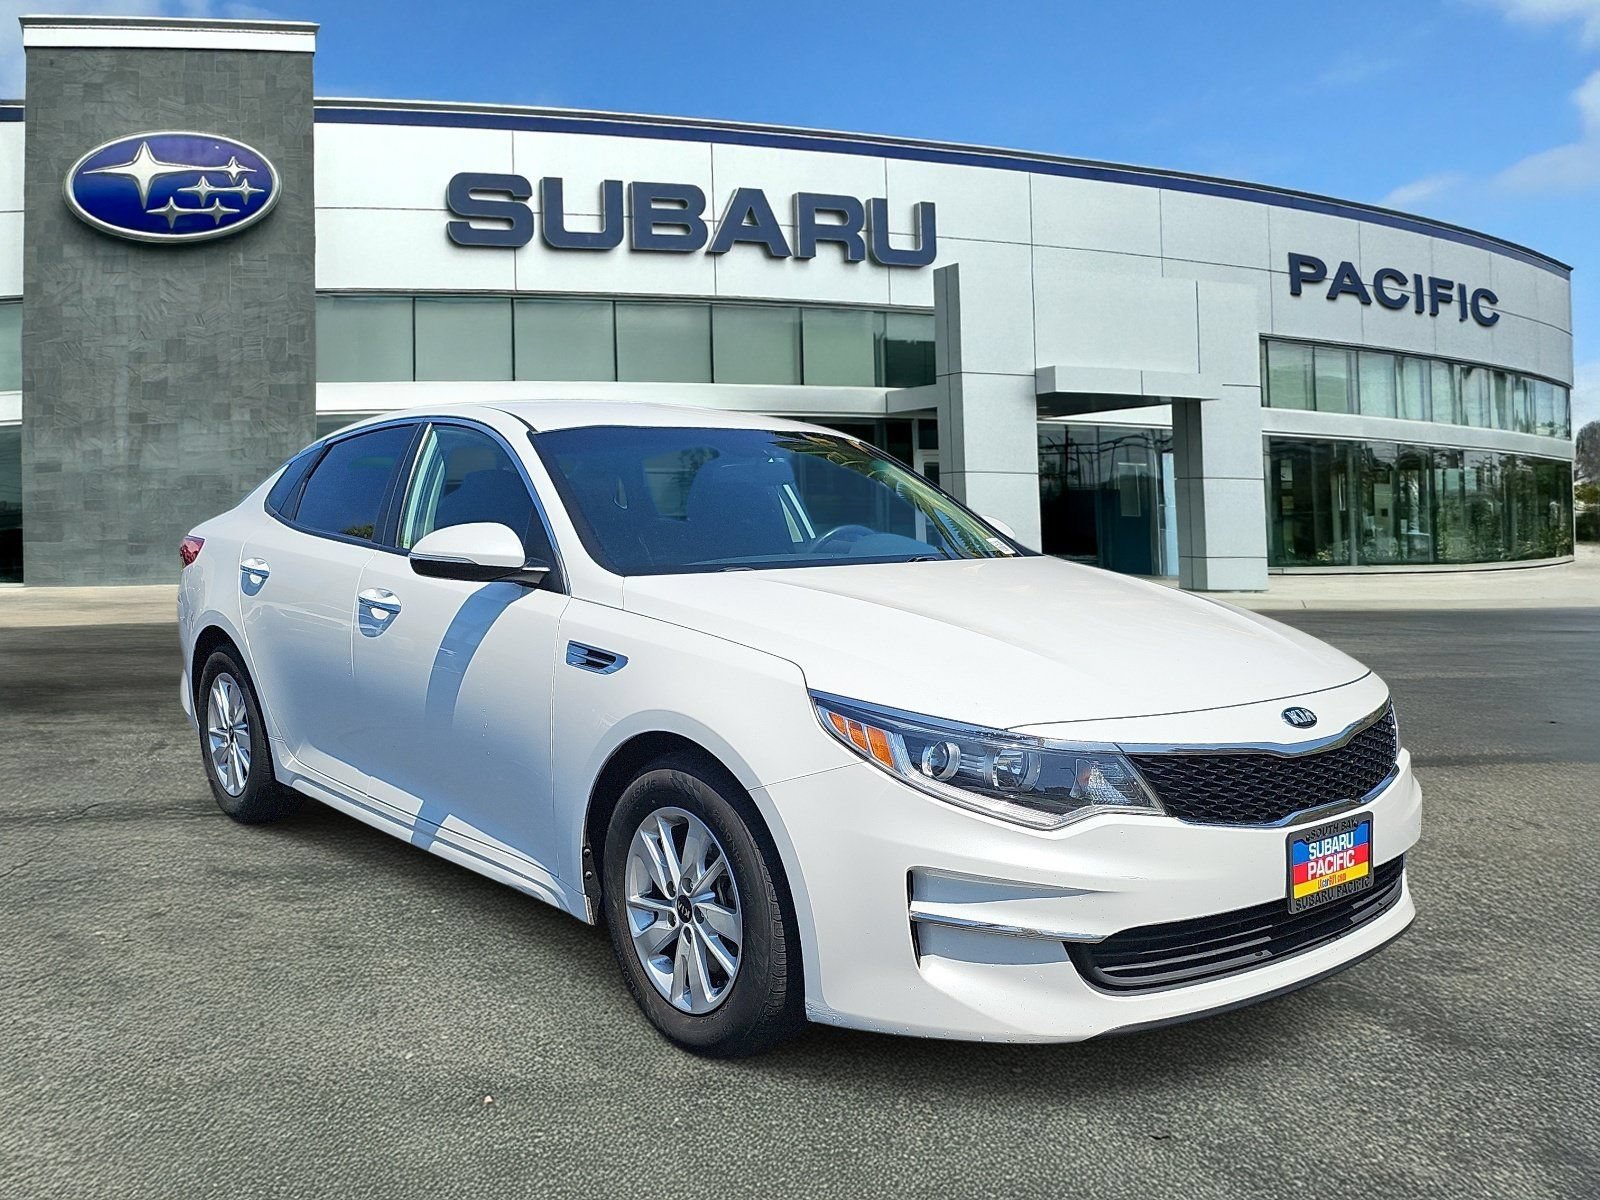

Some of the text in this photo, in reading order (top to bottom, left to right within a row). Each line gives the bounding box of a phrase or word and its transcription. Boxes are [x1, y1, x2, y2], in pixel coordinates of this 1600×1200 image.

[446, 172, 937, 267] SUBARU
[1288, 252, 1500, 327] PACIFIC
[1285, 708, 1316, 725] KIA
[1310, 823, 1339, 839] SOUTH
[1308, 832, 1354, 860] SUBARU
[1307, 849, 1355, 880] PACIFIC
[1295, 878, 1370, 911] SUBARU PACIFIC
[677, 901, 691, 919] KIA
